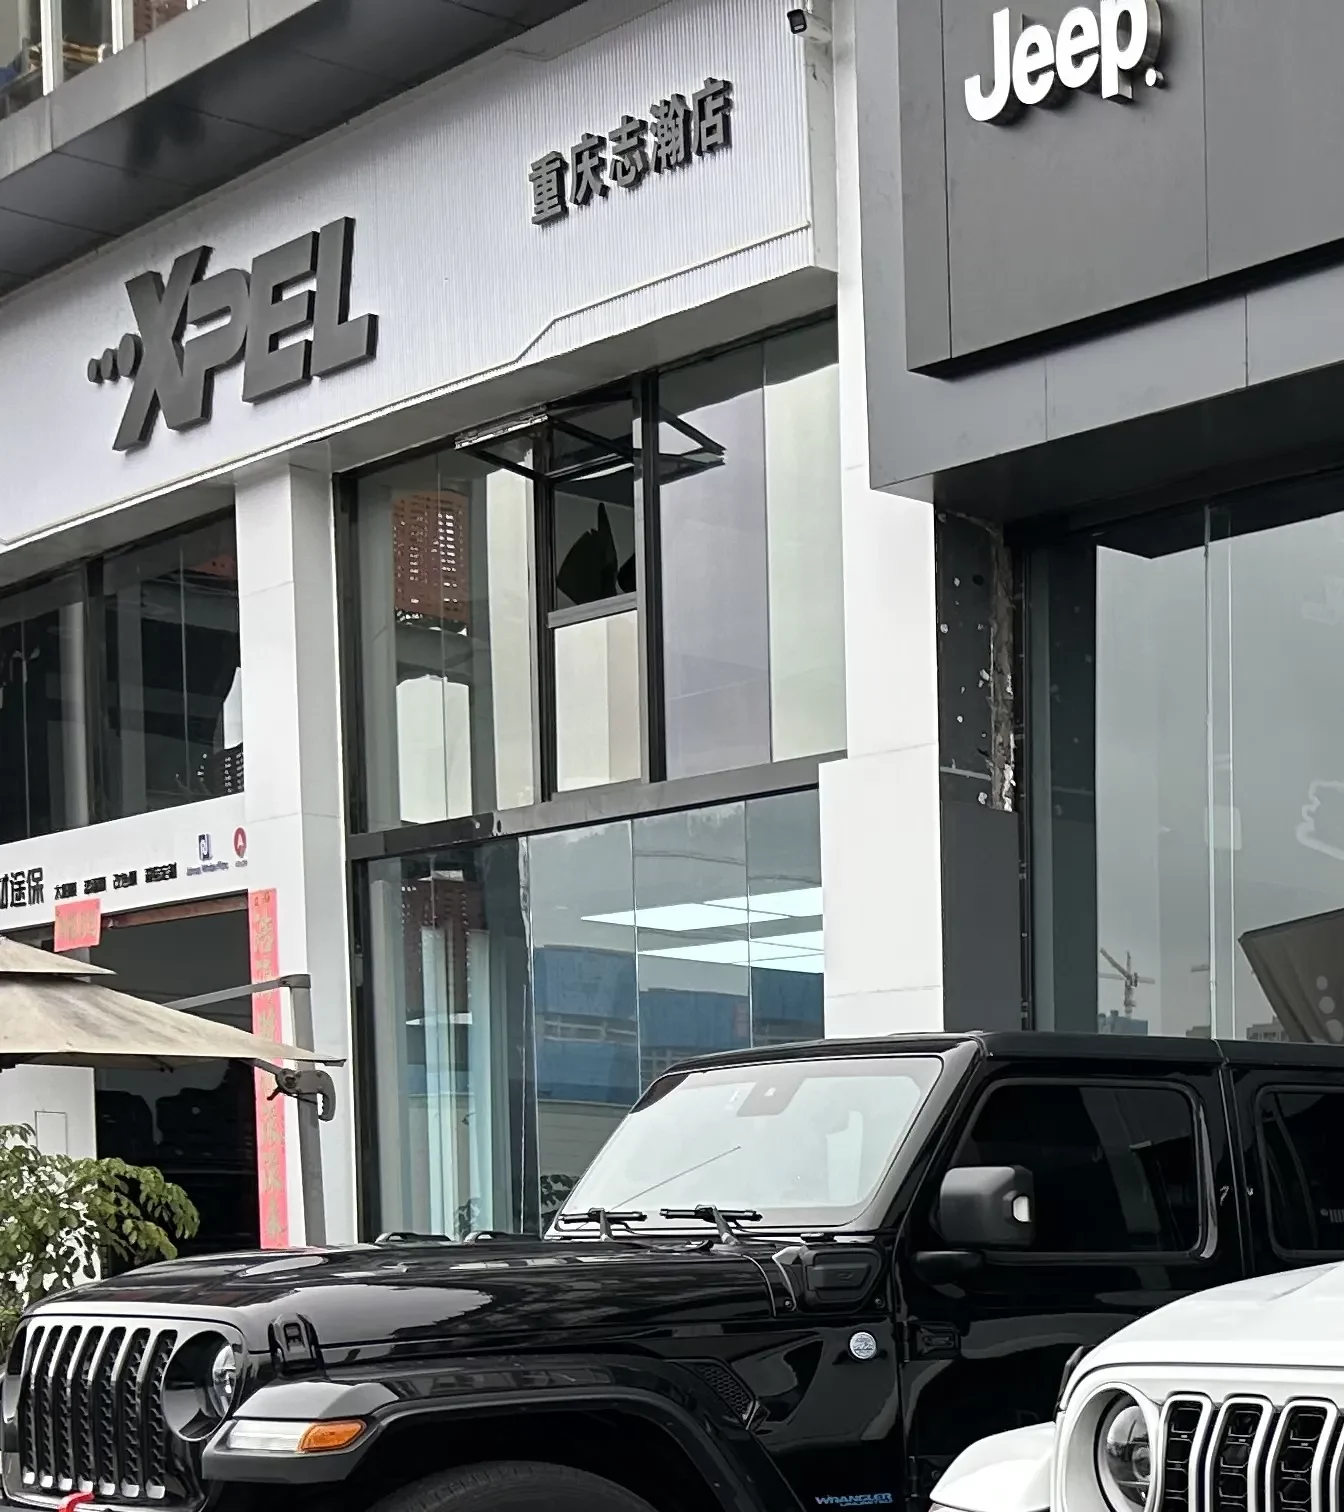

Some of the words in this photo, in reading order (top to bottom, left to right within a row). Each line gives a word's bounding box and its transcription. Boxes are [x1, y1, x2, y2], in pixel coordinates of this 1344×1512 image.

[964, 0, 1150, 121] Jeep
[529, 78, 731, 226] 重庆志瀚店
[112, 217, 378, 453] XPEL
